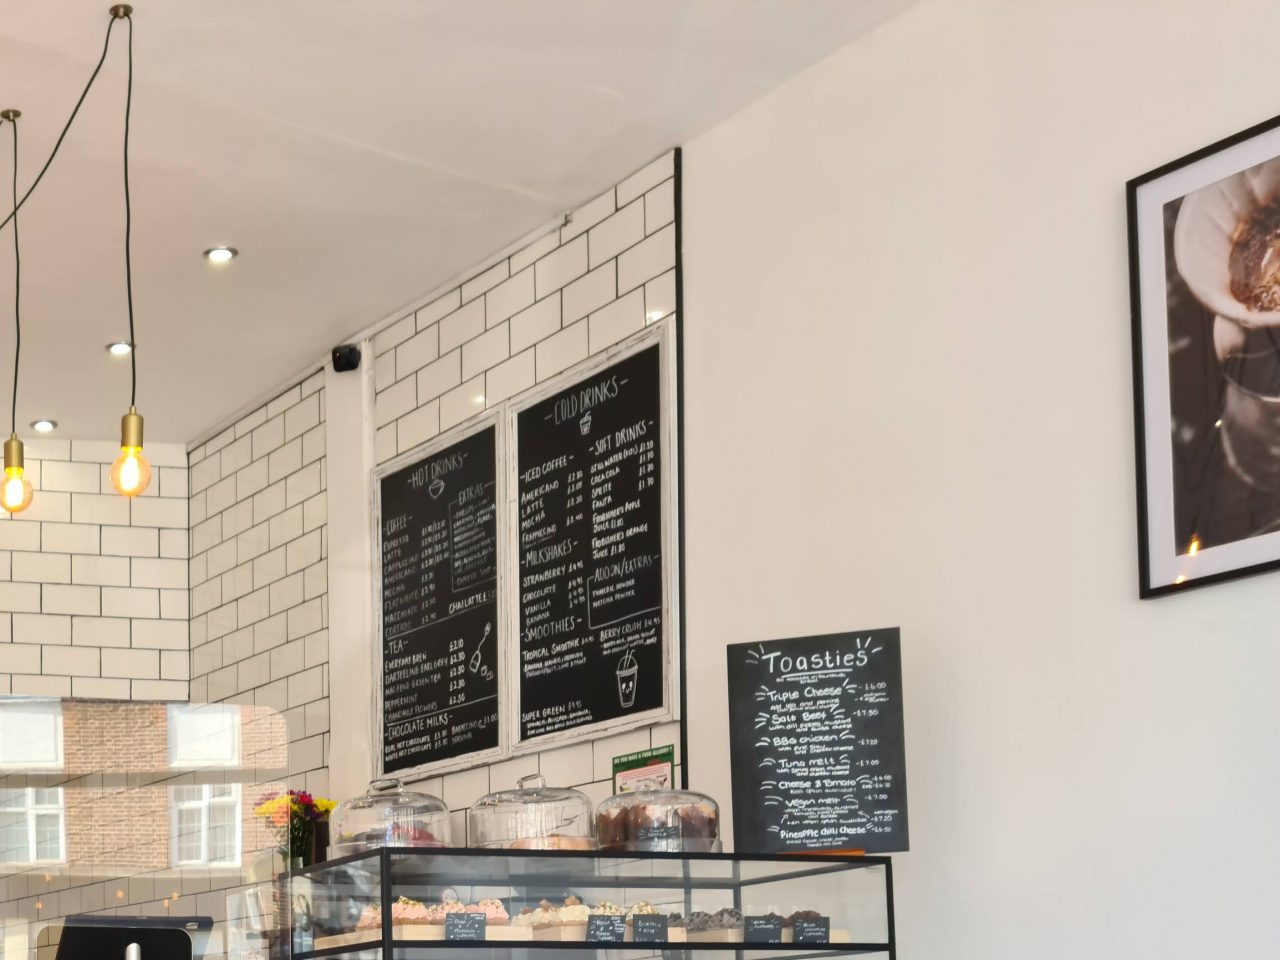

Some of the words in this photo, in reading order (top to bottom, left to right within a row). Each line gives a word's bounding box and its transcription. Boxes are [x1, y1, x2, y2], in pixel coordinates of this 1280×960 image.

[554, 394, 578, 425] COLD
[580, 376, 618, 413] DRINKS
[595, 435, 611, 455] SOFT
[615, 420, 646, 447] DRINKS
[412, 465, 428, 488] HOT
[431, 452, 463, 480] DRINKS
[524, 466, 541, 483] ICED
[542, 455, 567, 474] COFFEE
[458, 483, 483, 505] EXTRAS
[521, 480, 559, 505] AMERICANO
[591, 482, 611, 498] SPRITE
[521, 498, 544, 518] LATTE
[592, 495, 612, 510] FANTA
[522, 510, 545, 530] MOCHA
[384, 548, 401, 563] LATTE
[526, 539, 571, 567] MILKSHAKES
[523, 564, 566, 587] STRAWBERRY
[525, 599, 551, 615] VANILLA
[524, 615, 574, 642] SMOOTHIES
[600, 627, 620, 642] BERRY
[388, 639, 403, 654] TEA
[522, 647, 549, 661] TROPICAL
[762, 650, 868, 673] Toasties
[766, 690, 799, 702] Triple
[804, 686, 842, 697] Cheese
[522, 710, 540, 722] SUPER
[542, 705, 565, 717] GREEN
[771, 714, 796, 724] Salt
[802, 711, 827, 721] Beef
[388, 719, 424, 740] CHOCOLATE
[426, 713, 448, 728] MILKS
[799, 734, 838, 743] chicken
[778, 759, 805, 768] Tuna
[778, 781, 811, 789] Cheese
[822, 779, 856, 787] Tomato
